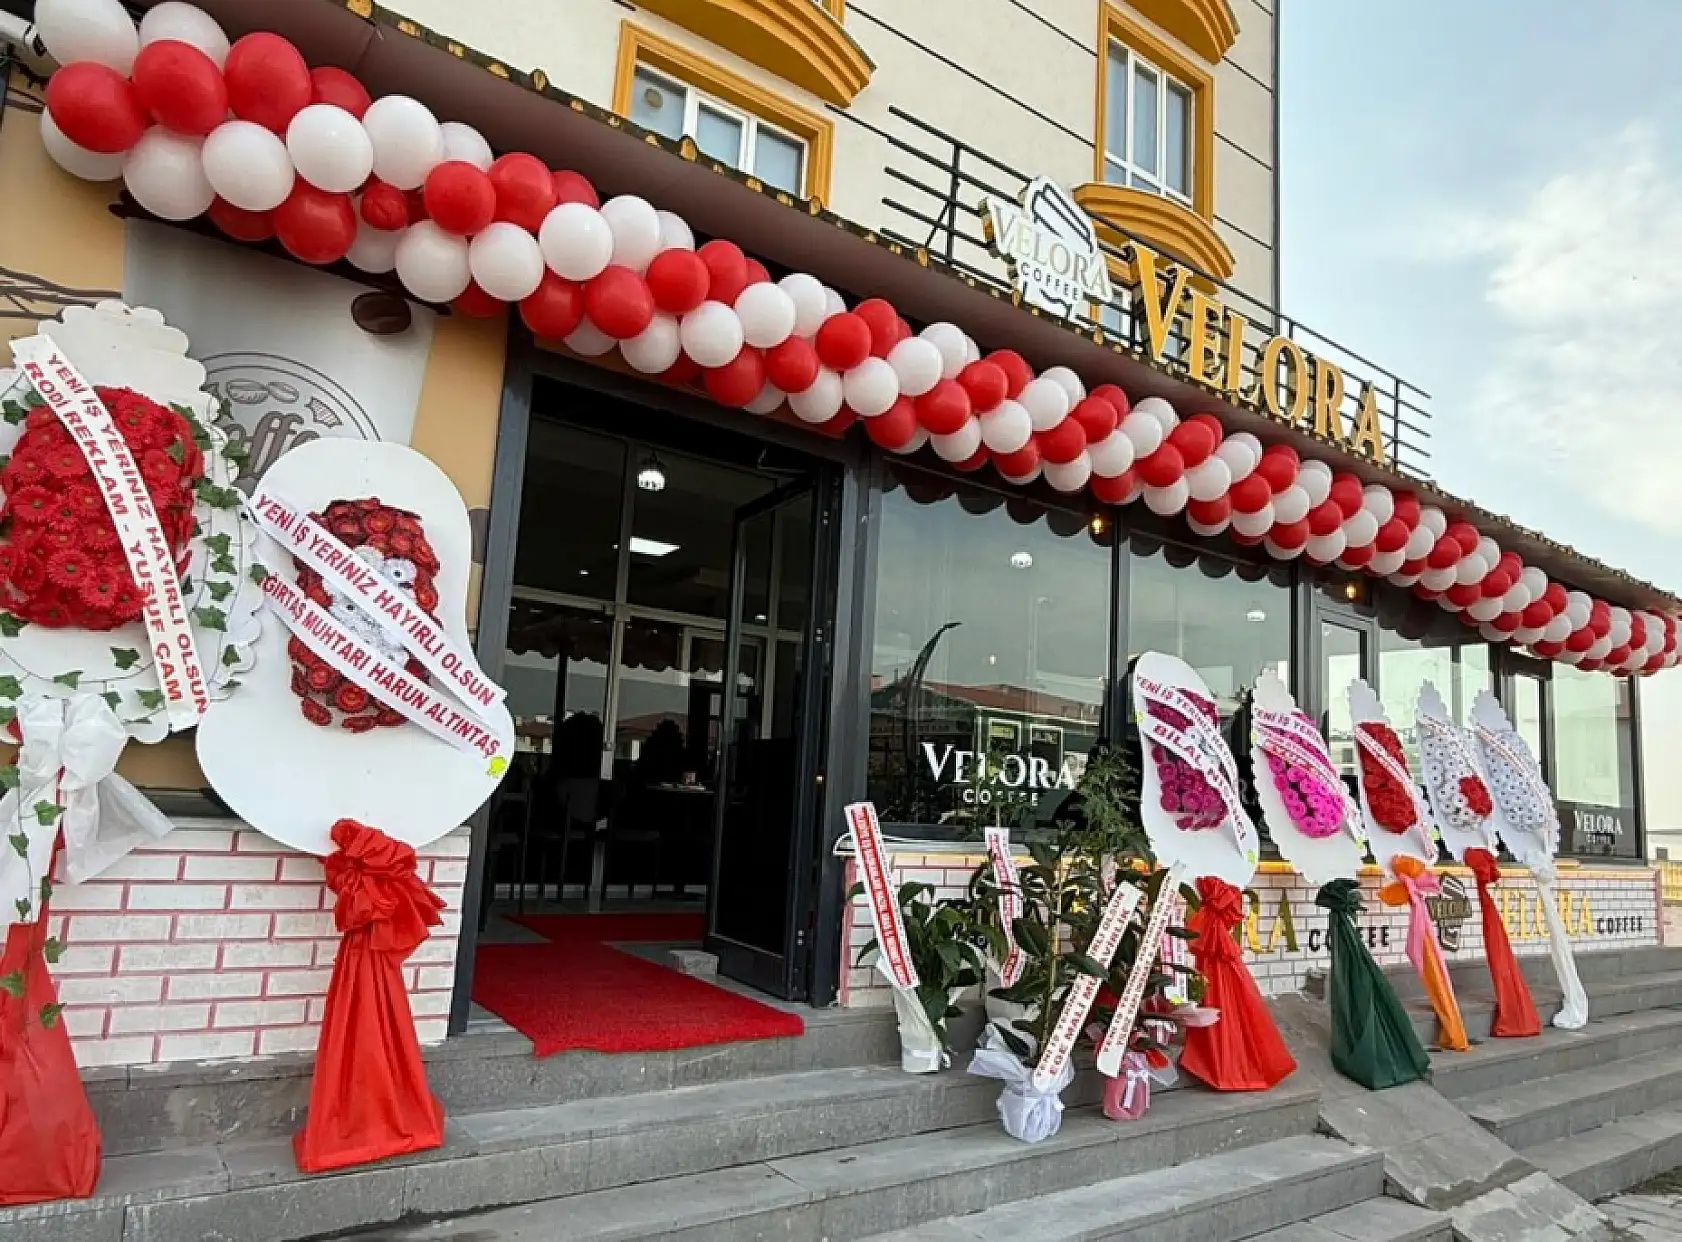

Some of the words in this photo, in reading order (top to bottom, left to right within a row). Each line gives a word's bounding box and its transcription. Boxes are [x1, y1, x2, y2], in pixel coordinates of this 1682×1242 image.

[988, 196, 1110, 298] VELORA
[1020, 262, 1079, 301] COFFEE
[1131, 240, 1386, 464] VELORA
[48, 354, 88, 394] YENİ
[99, 424, 153, 520] YERİNİZ
[145, 526, 186, 627] HAYIRLI
[176, 633, 209, 715] OLSUN
[63, 411, 129, 516] REKLAM
[128, 540, 166, 633] YUSUF
[255, 493, 300, 532] YENİ
[292, 517, 311, 548] İŞ
[308, 533, 380, 597] YERİNİZ
[373, 589, 446, 658] HAYIRLI
[440, 652, 497, 707] OLSUN
[301, 610, 372, 672] MUHTARI
[367, 661, 430, 710] HARUN
[424, 701, 501, 760] ALTINTAŞ
[1596, 915, 1643, 935] COFFEE
